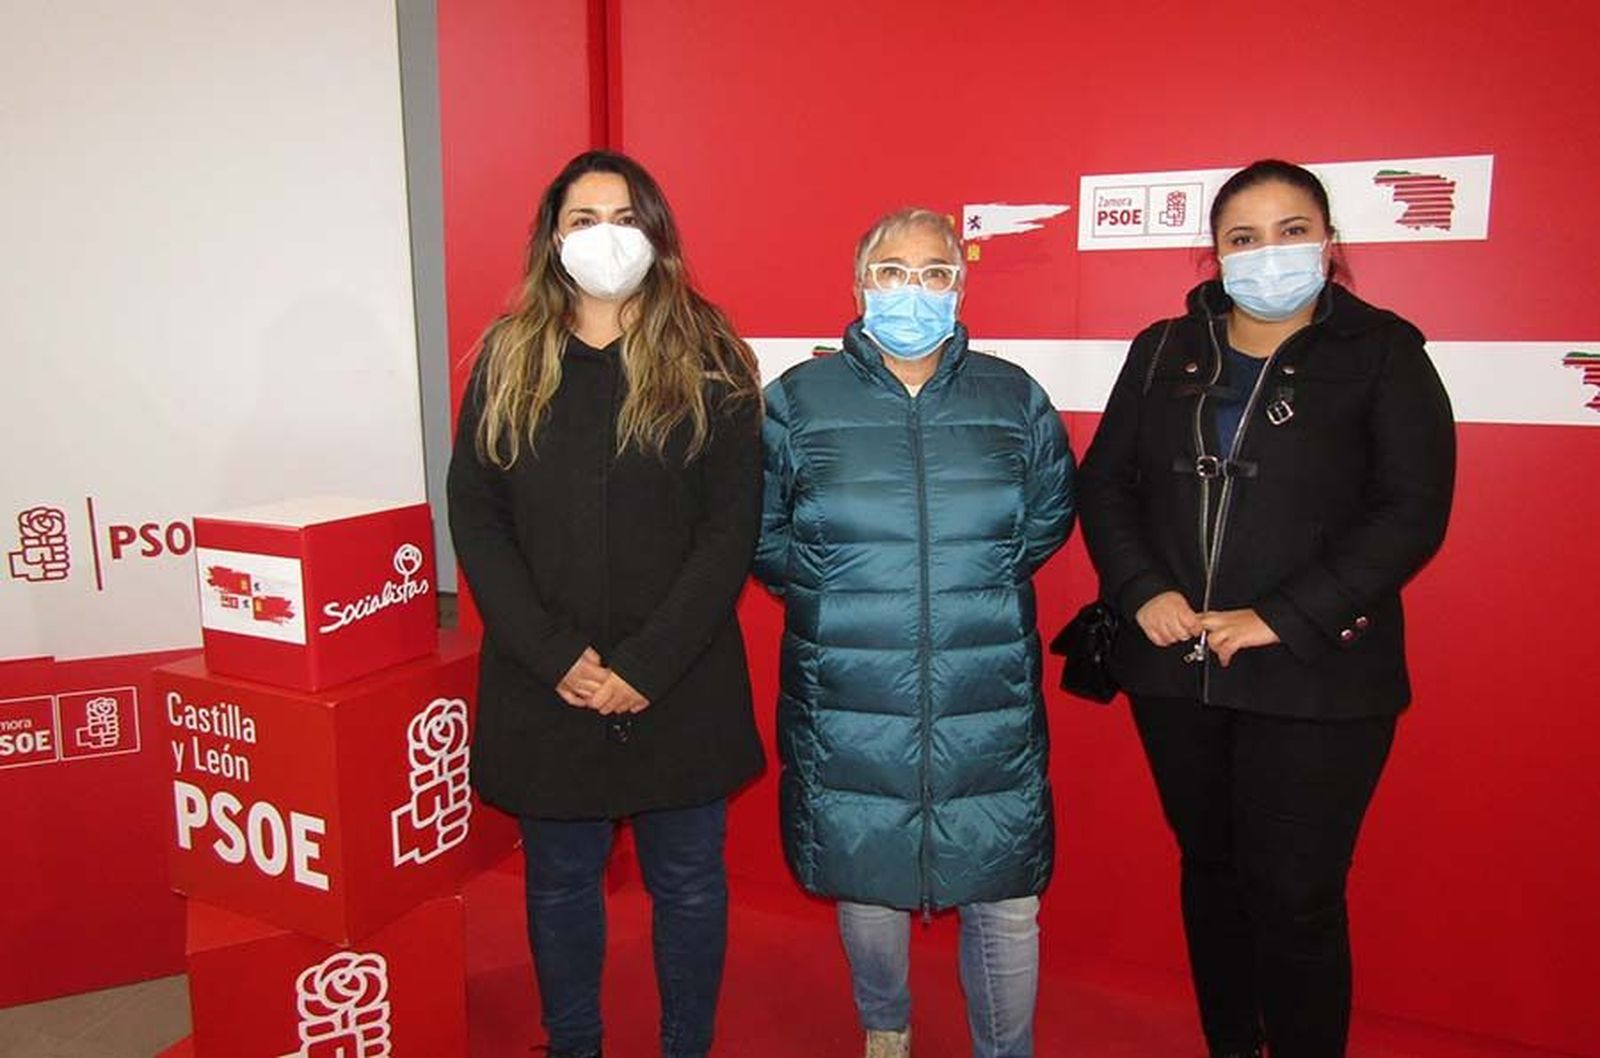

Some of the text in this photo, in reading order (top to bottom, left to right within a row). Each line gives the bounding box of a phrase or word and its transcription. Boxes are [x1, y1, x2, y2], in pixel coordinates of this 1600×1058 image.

[1097, 209, 1142, 226] PSOE
[1098, 196, 1132, 207] Zamora
[319, 577, 430, 634] Socialistas
[166, 691, 257, 744] Castilla
[172, 738, 250, 783] y León
[173, 781, 330, 892] PSOE
